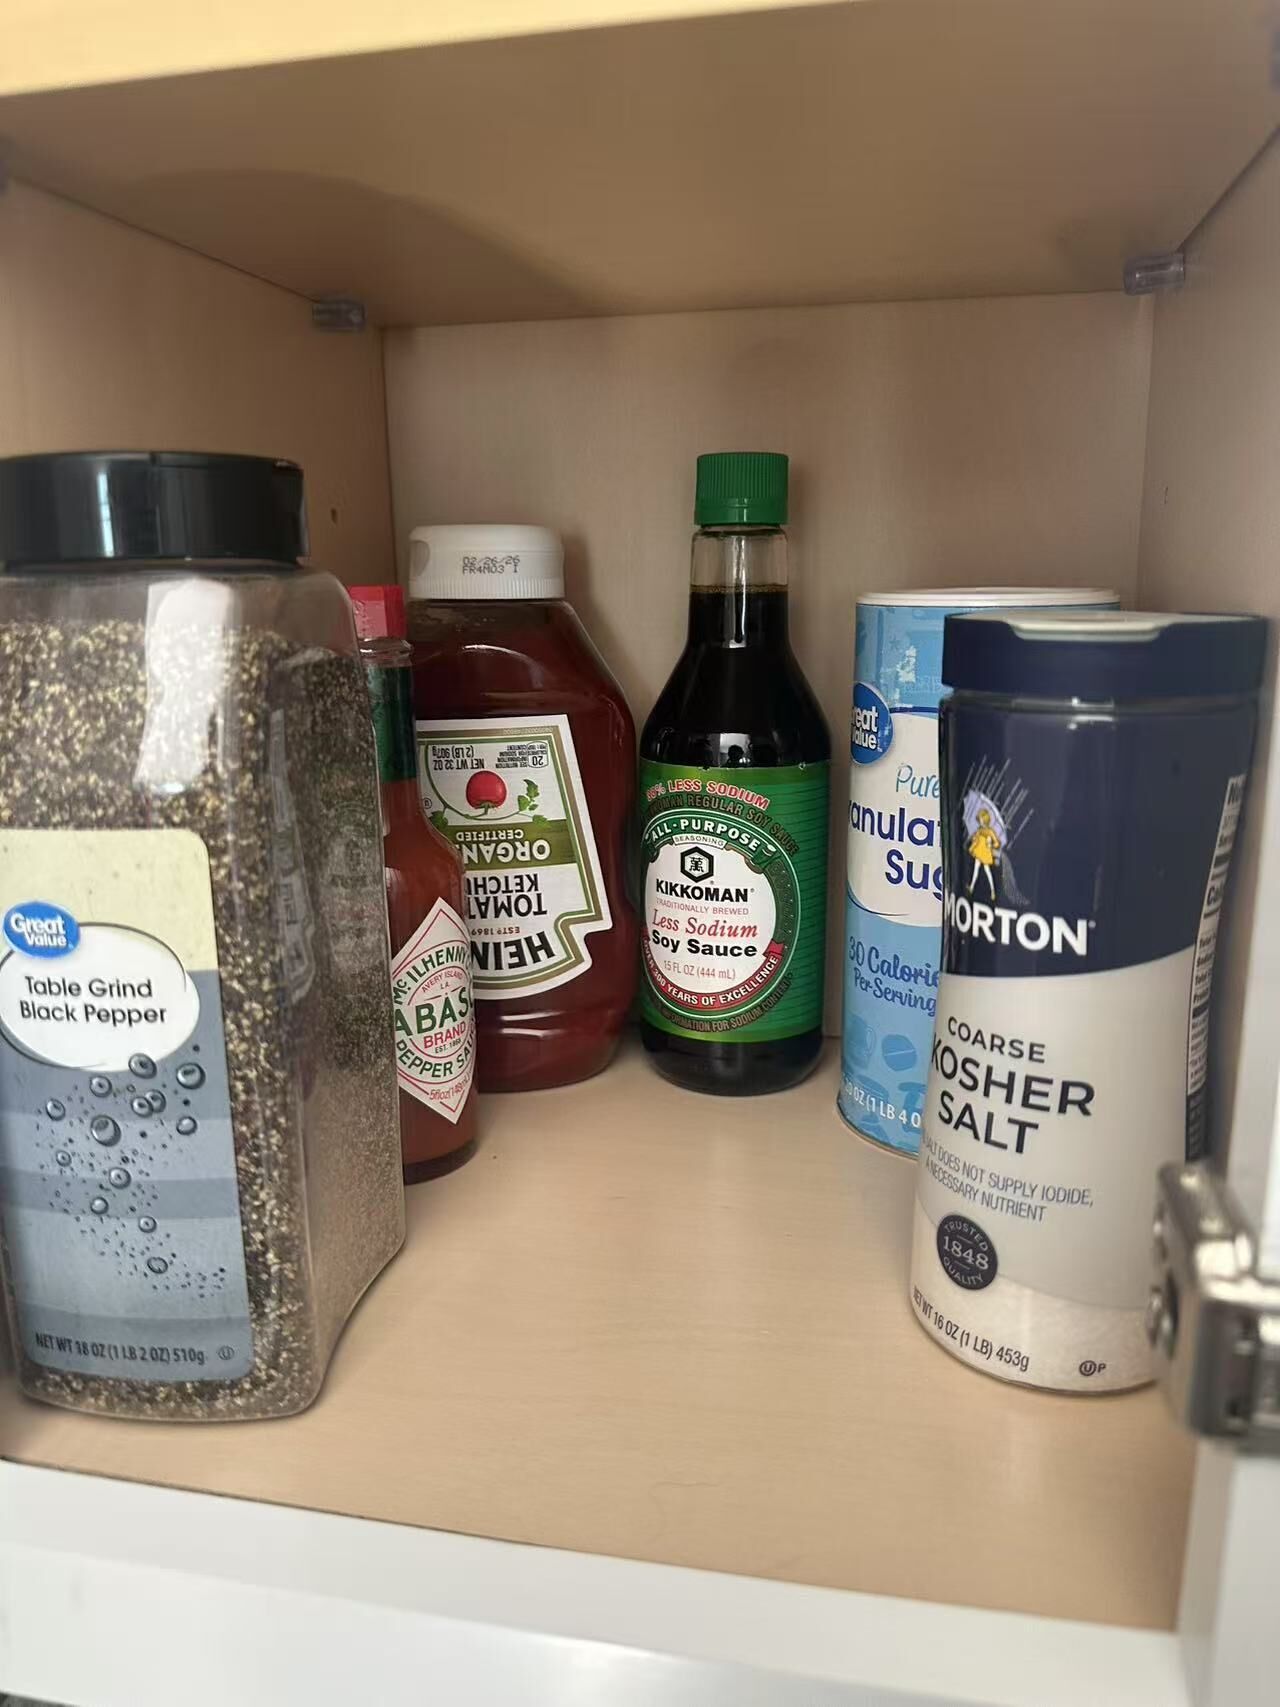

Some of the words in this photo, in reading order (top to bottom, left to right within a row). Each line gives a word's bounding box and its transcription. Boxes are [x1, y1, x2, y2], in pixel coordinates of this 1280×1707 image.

[852, 705, 878, 732] eat
[852, 727, 877, 749] alue
[433, 760, 443, 770] OZ
[445, 759, 454, 770] 32
[456, 759, 469, 769] WT
[470, 758, 484, 769] NET
[668, 779, 702, 792] LESS
[706, 780, 770, 810] SODIUM
[687, 794, 744, 816] REGULAR
[456, 829, 524, 842] CERTIFIED
[849, 800, 941, 847] anula
[457, 839, 551, 864] ORGAN
[656, 879, 748, 902] KIKKOMAN
[468, 893, 547, 920] TOMAT
[656, 898, 709, 914] TRADITIONALLY
[713, 907, 749, 916] BREWED
[11, 912, 65, 934] Great
[471, 927, 494, 936] 1869
[652, 909, 679, 932] Less
[685, 917, 758, 938] Sodium
[946, 893, 1087, 956] MORTON
[25, 929, 67, 947] Value
[471, 931, 556, 971] HEIN
[652, 930, 680, 953] Soy
[687, 938, 757, 957] Sauce
[850, 935, 864, 967] 30
[666, 984, 698, 1004] YEARS
[701, 996, 716, 1006] OF
[720, 955, 779, 1004] EXCELLENCE
[684, 964, 694, 976] OZ
[25, 976, 81, 996] Table
[88, 978, 152, 998] Grind
[20, 1000, 77, 1022] Black
[84, 1003, 167, 1027] Pepper
[394, 987, 472, 1036] ABAS
[424, 1021, 466, 1049] BRAND
[948, 1016, 1045, 1063] COARSE
[396, 1040, 453, 1077] PEPPER
[932, 1032, 1095, 1117] KOSHER
[880, 1101, 895, 1119] LB
[898, 1109, 907, 1124] 4
[911, 1112, 921, 1128] O
[938, 1090, 1038, 1154] SALT
[938, 1146, 960, 1172] DOES
[962, 1161, 985, 1183] NOT
[989, 1173, 1038, 1199] SUPPLY
[1041, 1185, 1094, 1208] IODIDE,
[930, 1160, 979, 1200] NECESSARY
[981, 1192, 1047, 1222] NUTRIENT
[944, 1221, 988, 1251] TRUSTED
[944, 1236, 989, 1270] 1848
[943, 1257, 983, 1285] QUALITY
[35, 1332, 53, 1348] NET
[56, 1337, 72, 1354] WT
[92, 1344, 106, 1358] OZ
[108, 1345, 119, 1361] (1
[123, 1346, 137, 1360] LB
[140, 1347, 147, 1361] 2
[150, 1346, 170, 1364] OZ)
[174, 1348, 205, 1365] 510g
[934, 1311, 944, 1330] 16
[945, 1320, 960, 1340] OZ
[960, 1330, 970, 1348] (1
[973, 1335, 993, 1360] LB)
[996, 1346, 1030, 1372] 453g
